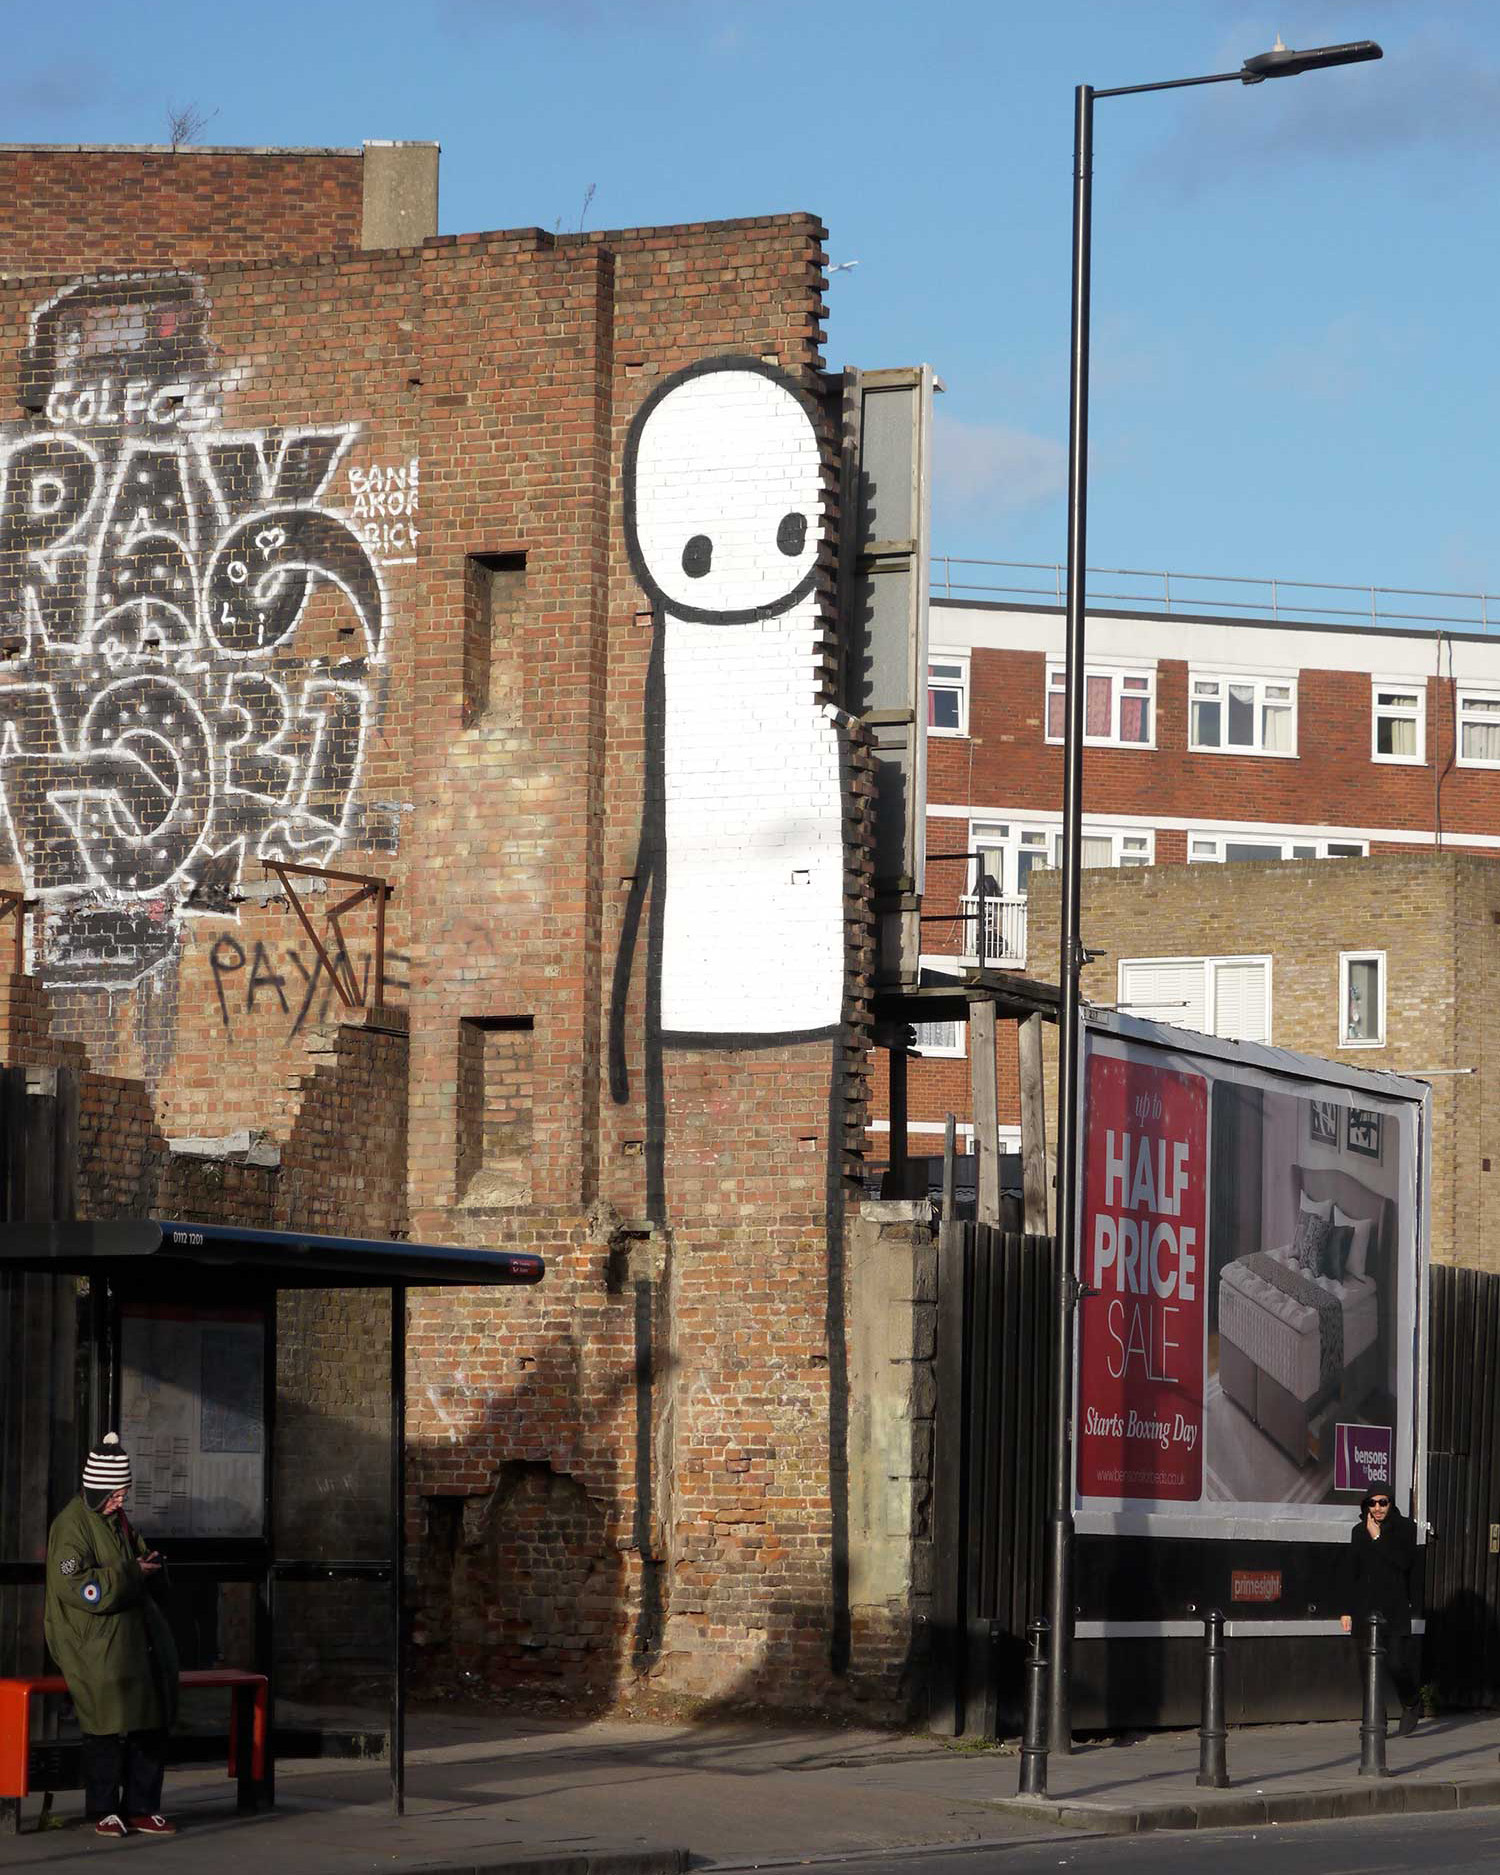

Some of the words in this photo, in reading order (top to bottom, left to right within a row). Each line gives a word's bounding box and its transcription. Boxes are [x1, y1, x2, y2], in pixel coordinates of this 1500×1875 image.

[1136, 1091, 1151, 1128] up
[1152, 1093, 1162, 1120] to
[1105, 1129, 1189, 1216] HALF
[1093, 1213, 1196, 1301] PRICE
[1107, 1299, 1180, 1383] SALE
[1084, 1406, 1124, 1437] Starts
[1126, 1410, 1171, 1450] Boxing
[1173, 1413, 1198, 1452] Day
[1354, 1446, 1388, 1465] bensons
[1367, 1463, 1388, 1482] beds
[1234, 1574, 1280, 1600] primesight
